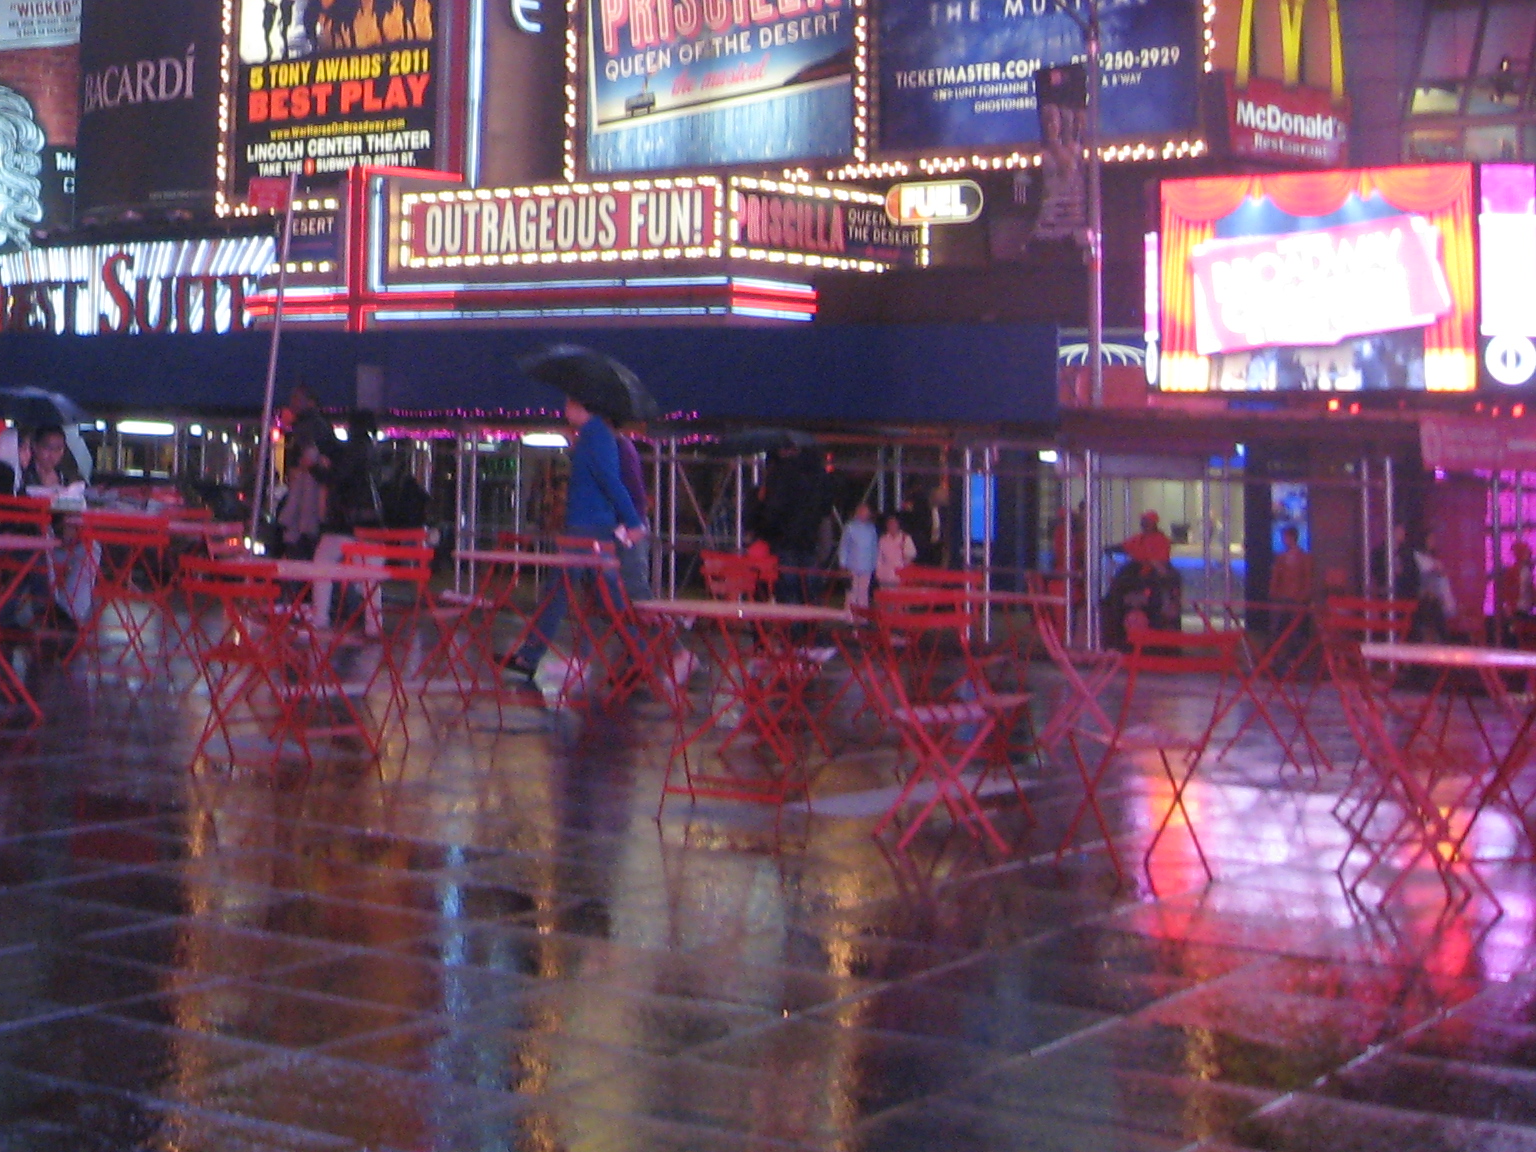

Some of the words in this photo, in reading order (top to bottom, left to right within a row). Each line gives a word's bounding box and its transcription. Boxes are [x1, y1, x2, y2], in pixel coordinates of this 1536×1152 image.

[930, 0, 980, 26] THE
[605, 47, 671, 81] QUEEN
[679, 41, 705, 63] OF
[712, 30, 752, 58] THE
[760, 11, 841, 48] DESERT
[250, 66, 264, 90] 5
[269, 61, 312, 89] TONY
[389, 48, 430, 76] 2011
[248, 83, 334, 124] BEST
[340, 72, 431, 115] PLAY
[1236, 98, 1347, 142] McDonald's
[247, 139, 305, 163] LINCOLN
[307, 135, 363, 158] CENTER
[366, 130, 431, 153] THEATER
[258, 161, 283, 177] TAKE
[316, 155, 356, 174] SUBWAY
[848, 207, 886, 227] QUEEN
[901, 185, 967, 218] FUEL
[424, 195, 618, 258] OUTRAGEOUS
[630, 189, 704, 248] FUN!
[734, 192, 846, 253] PRISCILLA
[848, 226, 870, 243] THE
[873, 229, 920, 247] DESERT
